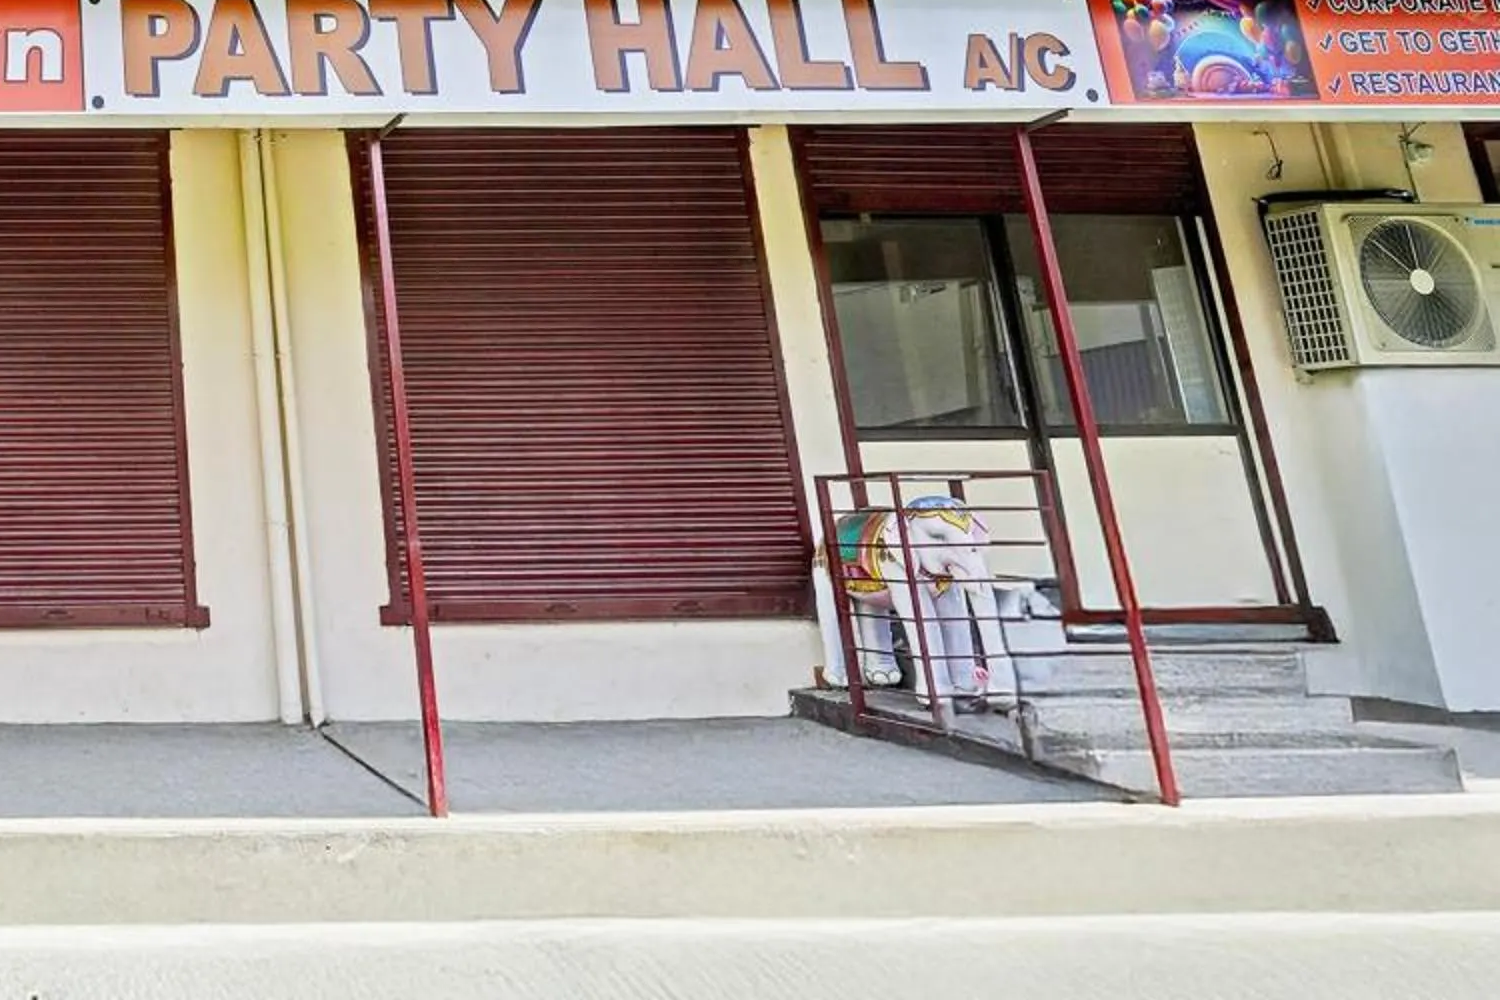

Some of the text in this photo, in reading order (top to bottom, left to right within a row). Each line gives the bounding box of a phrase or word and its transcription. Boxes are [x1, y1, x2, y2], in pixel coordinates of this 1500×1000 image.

[963, 31, 1076, 93] A/C
[1339, 31, 1387, 53] GET
[1395, 31, 1432, 53] TO
